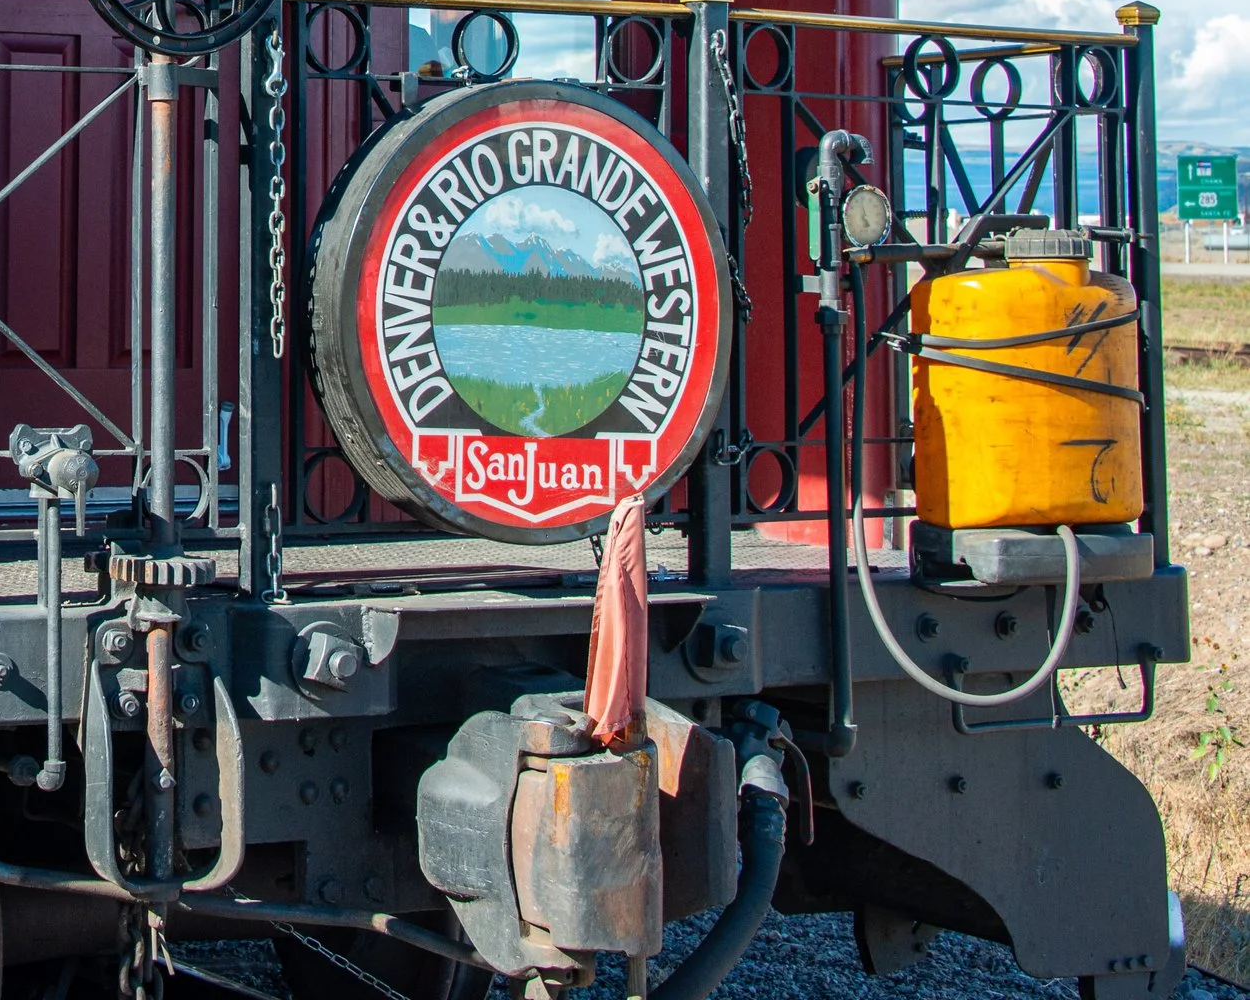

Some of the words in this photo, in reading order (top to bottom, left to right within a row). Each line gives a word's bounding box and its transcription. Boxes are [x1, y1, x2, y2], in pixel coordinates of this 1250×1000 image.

[384, 233, 454, 423] DENVER
[428, 145, 504, 217] RIO
[507, 129, 658, 231] GRANDE
[619, 211, 692, 432] WESTERN
